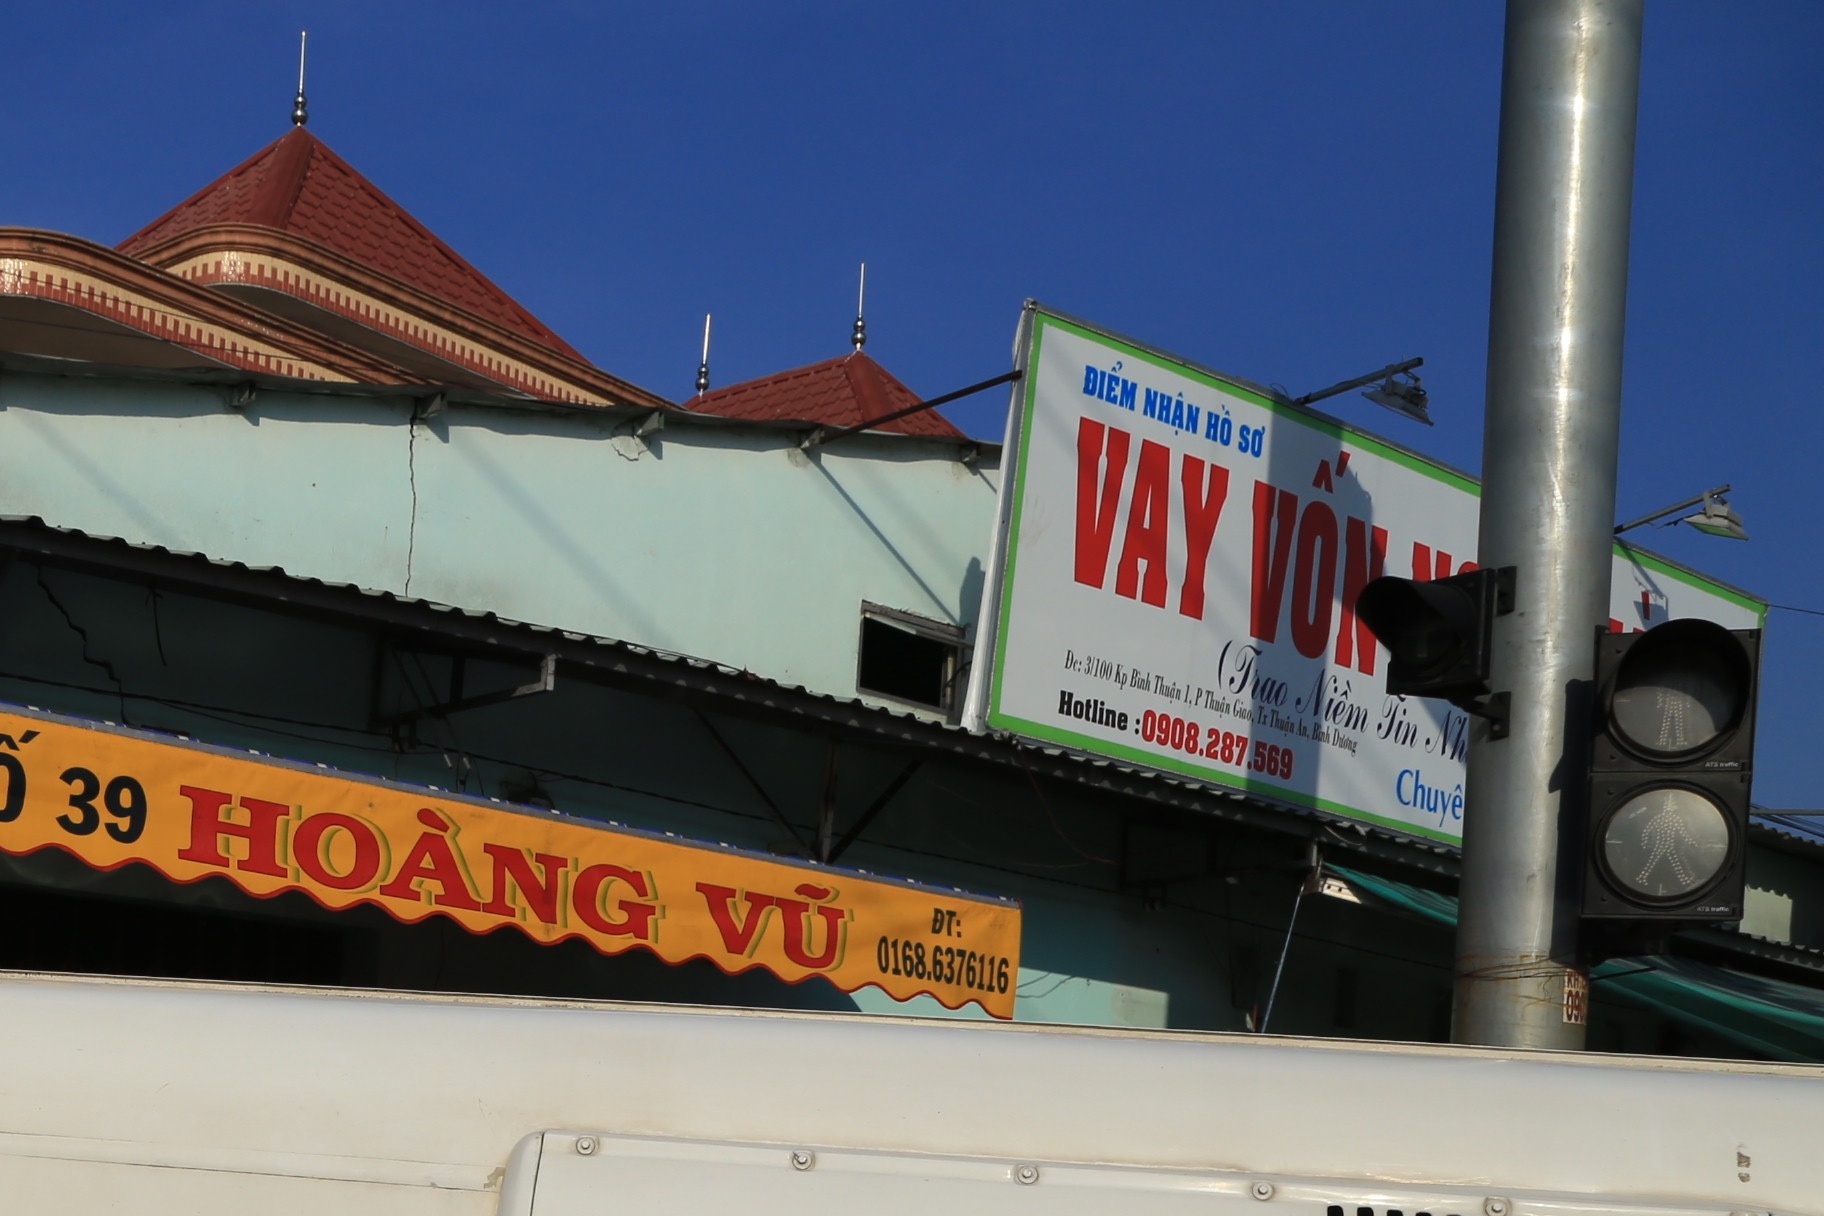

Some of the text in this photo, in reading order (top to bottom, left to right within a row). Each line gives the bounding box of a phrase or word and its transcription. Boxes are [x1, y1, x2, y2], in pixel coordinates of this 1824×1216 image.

[1083, 361, 1266, 458] ĐIỂM NHẬN HỒ SƠ
[1074, 416, 1388, 676] VAY VỐN
[1058, 690, 1128, 730] Hotline
[1064, 649, 1082, 673] Đc:
[1084, 655, 1113, 681] 3/100
[1114, 664, 1128, 690] Kp
[1129, 668, 1151, 692] Bình
[1153, 675, 1181, 704] Thuận
[1194, 688, 1203, 706] P
[1204, 690, 1230, 718] Thuận
[1233, 699, 1254, 725] Giao,
[1270, 709, 1295, 737] Thuận
[1218, 640, 1288, 707] (Trao
[1295, 668, 1369, 734] Niềm
[1425, 710, 1468, 764] Nh
[1396, 769, 1464, 828] Chuyê
[55, 766, 147, 844] 39
[177, 785, 661, 941] HOÀNG
[695, 882, 847, 969] VŨ
[877, 935, 1010, 995] 0168.6376116
[931, 907, 962, 938] ĐT:
